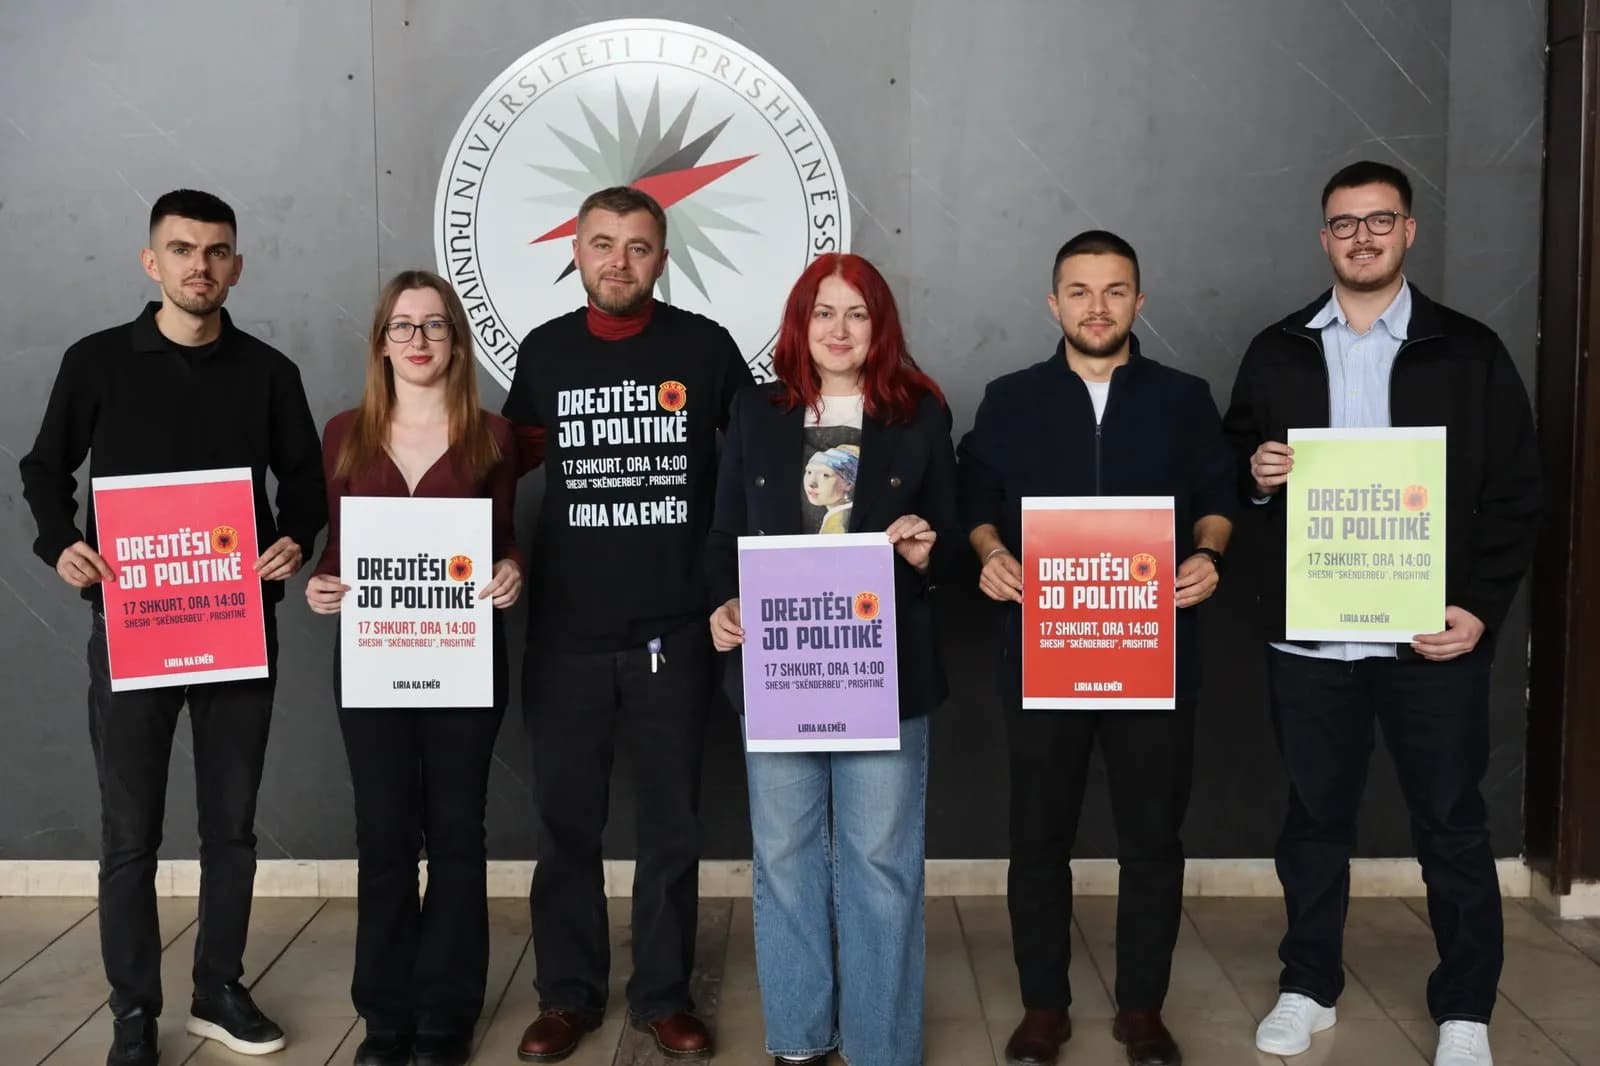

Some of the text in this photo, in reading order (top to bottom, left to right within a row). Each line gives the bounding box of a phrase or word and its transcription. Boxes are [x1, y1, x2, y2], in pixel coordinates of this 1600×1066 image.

[450, 235, 518, 371] UNIVERSIT
[558, 380, 656, 416] DREJTËSI
[559, 411, 687, 448] JO POLITIKË
[562, 455, 687, 475] 17 SHKURT, ORA 14:00
[566, 480, 587, 489] SHESHI
[649, 473, 687, 485] PRISHTINË
[1308, 484, 1400, 511] DREJTËSI
[569, 496, 688, 526] LIRIA KA EMËR
[1308, 512, 1430, 540] JO POLITIKË
[116, 528, 211, 561] DREJTËSI
[357, 553, 446, 580] DREJTËSI
[1039, 553, 1129, 581] DREJTËSI
[1308, 553, 1320, 566] 17
[1373, 553, 1394, 566] ORA
[1400, 553, 1430, 566] 14:00
[119, 552, 242, 589] JO POLITIKË
[1308, 571, 1333, 579] SHESHI
[122, 593, 245, 615] 17 SHKURT, ORA 14:00
[357, 582, 475, 609] JO POLITIKË
[1039, 581, 1159, 609] JO POLITIKË
[761, 592, 852, 621] DREJTËSI
[125, 618, 150, 628] SHESHI
[1340, 613, 1389, 623] LIRIA KA EMËR
[358, 621, 475, 636] 17 SHKURT, ORA 14:00
[762, 619, 882, 650] JO POLITIKË
[1040, 622, 1158, 637] 17 SHKURT, ORA 14:00
[440, 638, 475, 647] PRISHTINË
[1040, 640, 1064, 648] SHESHI
[1123, 638, 1158, 648] PRISHTINË
[165, 653, 214, 668] LIRIA KA EMËR
[765, 661, 884, 677] 17 SHKURT, ORA 14:00
[393, 679, 440, 689] LIRIA KA EMËR
[766, 681, 790, 689] SHESHI
[848, 678, 884, 688] PRISHTINË
[1074, 680, 1122, 691] LIRIA KA EMËR
[798, 722, 846, 733] LIRIA KA EMËR
